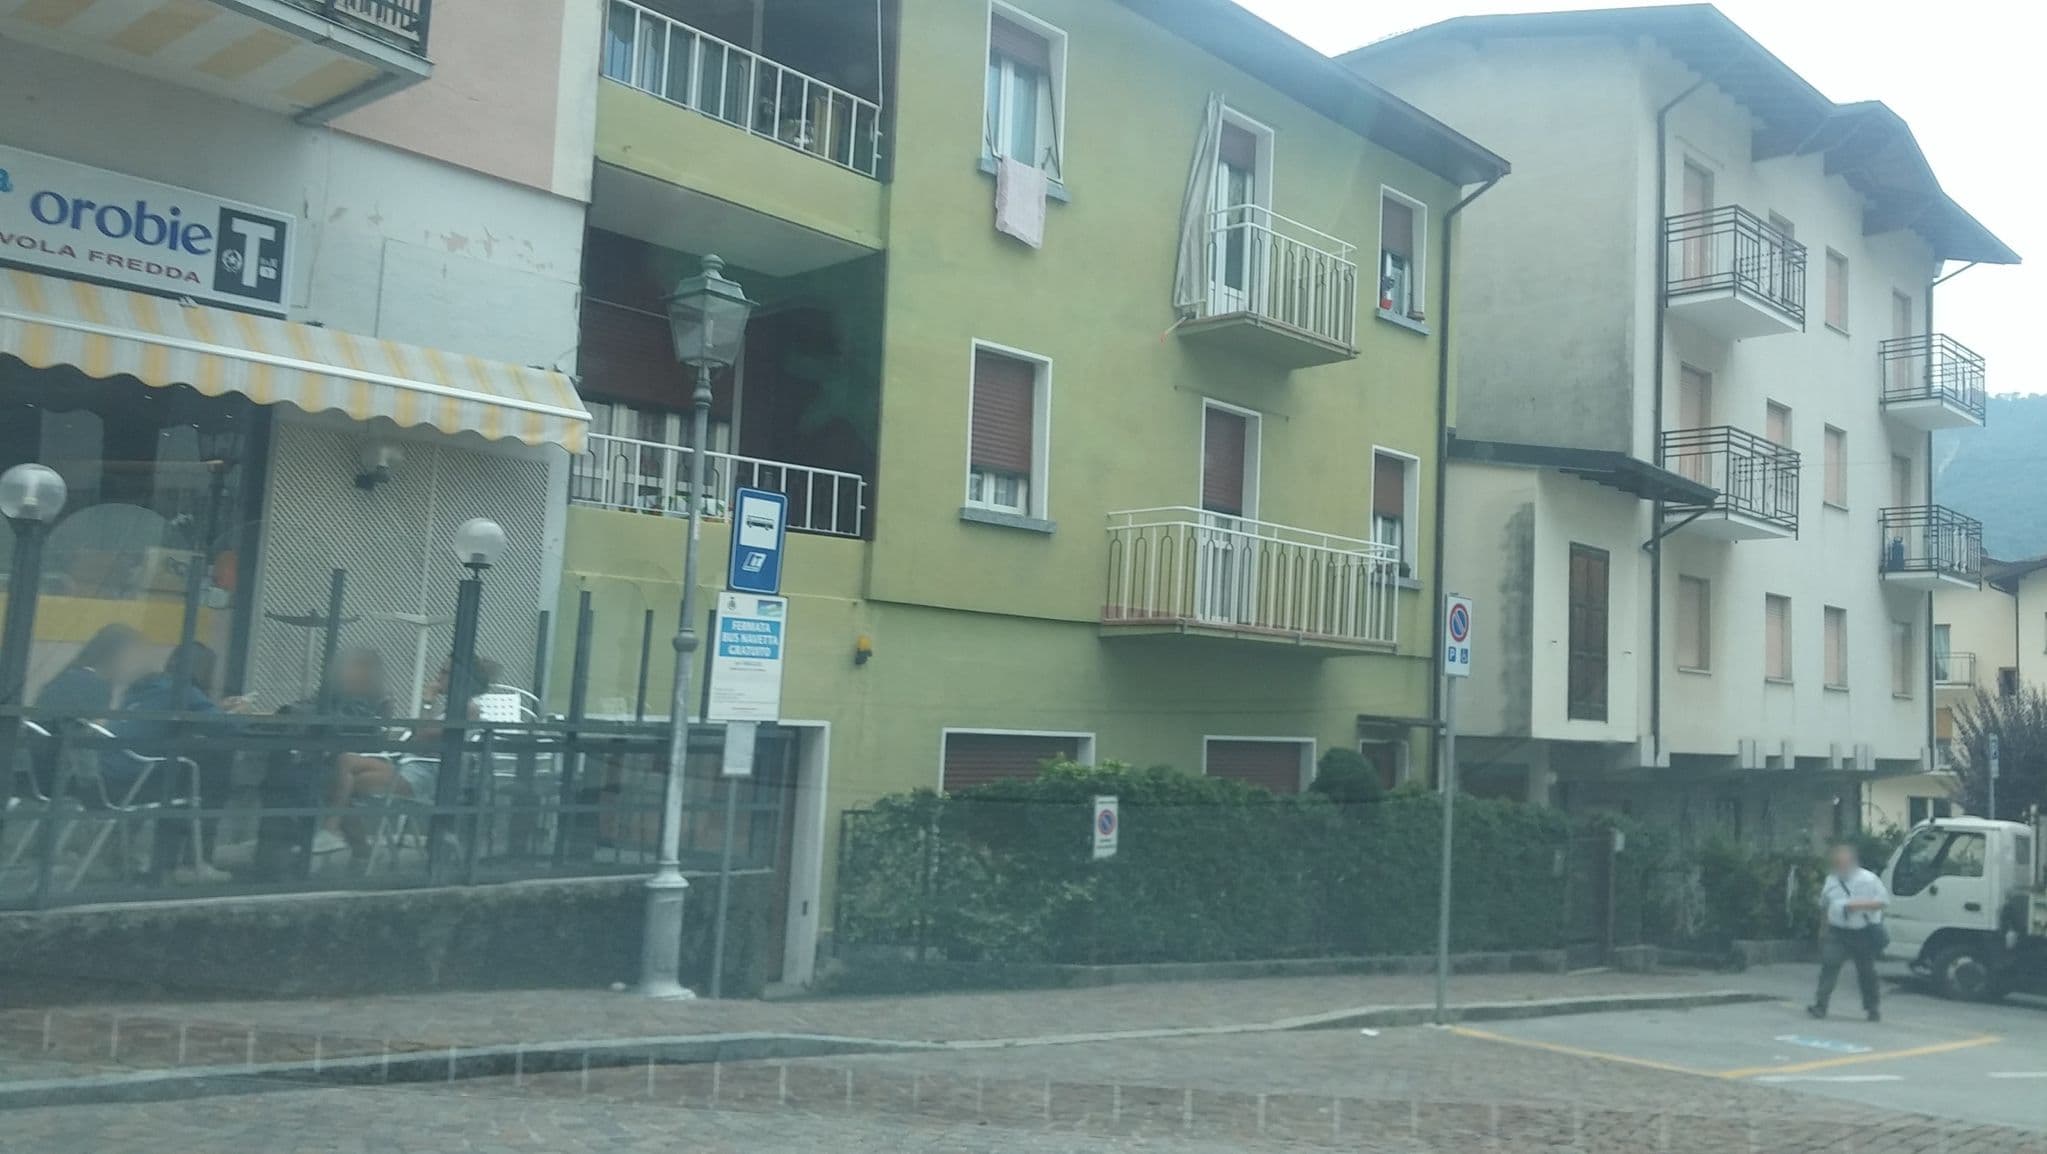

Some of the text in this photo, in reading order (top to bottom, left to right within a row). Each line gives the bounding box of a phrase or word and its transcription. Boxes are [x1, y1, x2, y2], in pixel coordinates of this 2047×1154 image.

[30, 191, 213, 256] orobie
[88, 249, 201, 284] FREDDA
[731, 620, 771, 632] FERMATA
